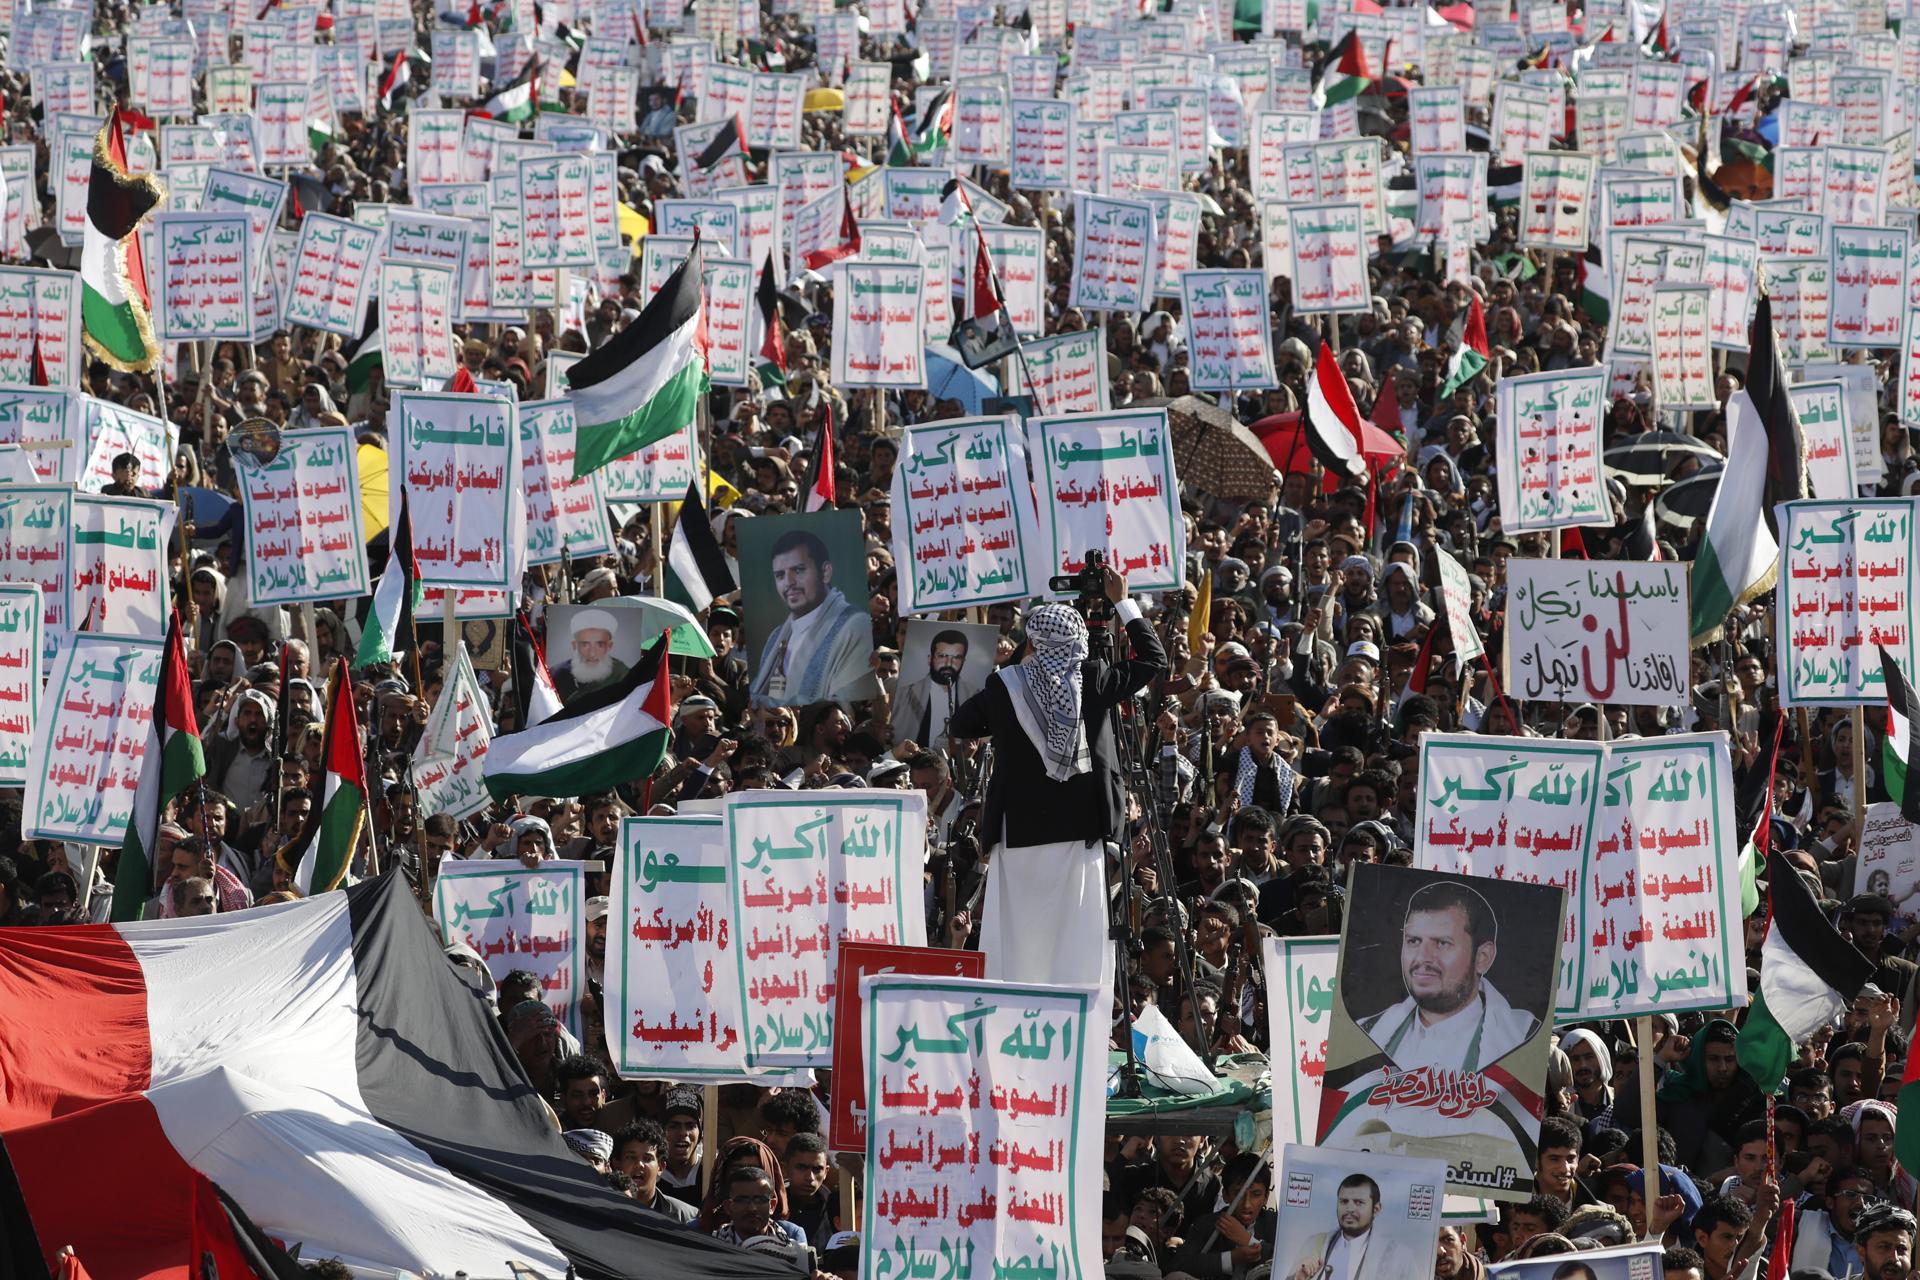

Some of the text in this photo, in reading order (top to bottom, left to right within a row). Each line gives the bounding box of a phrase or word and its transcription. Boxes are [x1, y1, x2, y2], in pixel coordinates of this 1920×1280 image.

[408, 414, 504, 450] قاطعوا
[1050, 428, 1159, 471] قاطعوا
[306, 441, 344, 467] الله
[906, 432, 1001, 474] الله أكبر
[251, 477, 346, 503] الموت لأمريكا
[408, 457, 503, 493] البضائع الأمريكية
[910, 471, 1006, 500] الموت لأمريكا
[1056, 475, 1161, 509] البضائع الأمريكية
[23, 499, 64, 528] الله
[255, 504, 349, 533] الموت لإسرائيل
[447, 500, 452, 524] و
[914, 501, 1011, 534] الموت لإسرائيل
[1105, 513, 1112, 536] و
[75, 517, 156, 549] قاطع
[256, 532, 352, 562] اللعنة على اليهود
[916, 530, 1015, 564] اللعنة على اليهود
[1791, 508, 1906, 554] الله أكبر
[16, 542, 64, 564] الموت
[414, 534, 500, 568] الإسرائيلي
[1791, 553, 1904, 581] الموت لأمريكا
[109, 564, 156, 596] البضائع
[258, 557, 357, 594] النصر للإسلام
[918, 557, 1019, 599] النصر للإسلام
[0, 601, 30, 632] الل
[100, 598, 106, 620] و
[1792, 592, 1904, 619] الموت لإسرائيل
[1582, 570, 1630, 699] لن
[1793, 625, 1833, 651] اليهود
[1840, 625, 1863, 649] على
[70, 646, 142, 688] أكبر
[1795, 658, 1852, 694] للإسلام
[64, 690, 125, 721] لأمريكا
[55, 724, 118, 759] لإسرائيل
[49, 762, 95, 790] اليهود
[96, 767, 118, 793] على
[1428, 755, 1589, 813] الله أكبر
[1603, 756, 1707, 807] الله أك
[43, 793, 102, 833] للإسلام
[741, 809, 892, 874] الله أكبر
[1428, 812, 1582, 855] الموت لأمريكا
[1597, 817, 1710, 861] الموت لأمر
[634, 840, 726, 893] عوا
[1643, 866, 1712, 902] الموت
[448, 877, 569, 932] الله أكبر
[743, 871, 892, 911] الموت لأمريكا
[1595, 869, 1636, 907] لإسرا
[520, 929, 568, 958] الموت
[633, 901, 714, 950] الأمريكية
[746, 924, 830, 960] لإسرائيل
[1623, 911, 1716, 952] اللعنة على
[702, 960, 712, 993] و
[749, 970, 808, 1006] اليهود
[1648, 950, 1719, 1004] النصر
[754, 1013, 832, 1064] للإسلام
[880, 998, 1072, 1069] الله أكبر
[881, 1068, 1068, 1119] الموت لأمريكا
[880, 1126, 1062, 1174] الموت لإسرائيل
[877, 1184, 1063, 1228] اللعنة على اليهود
